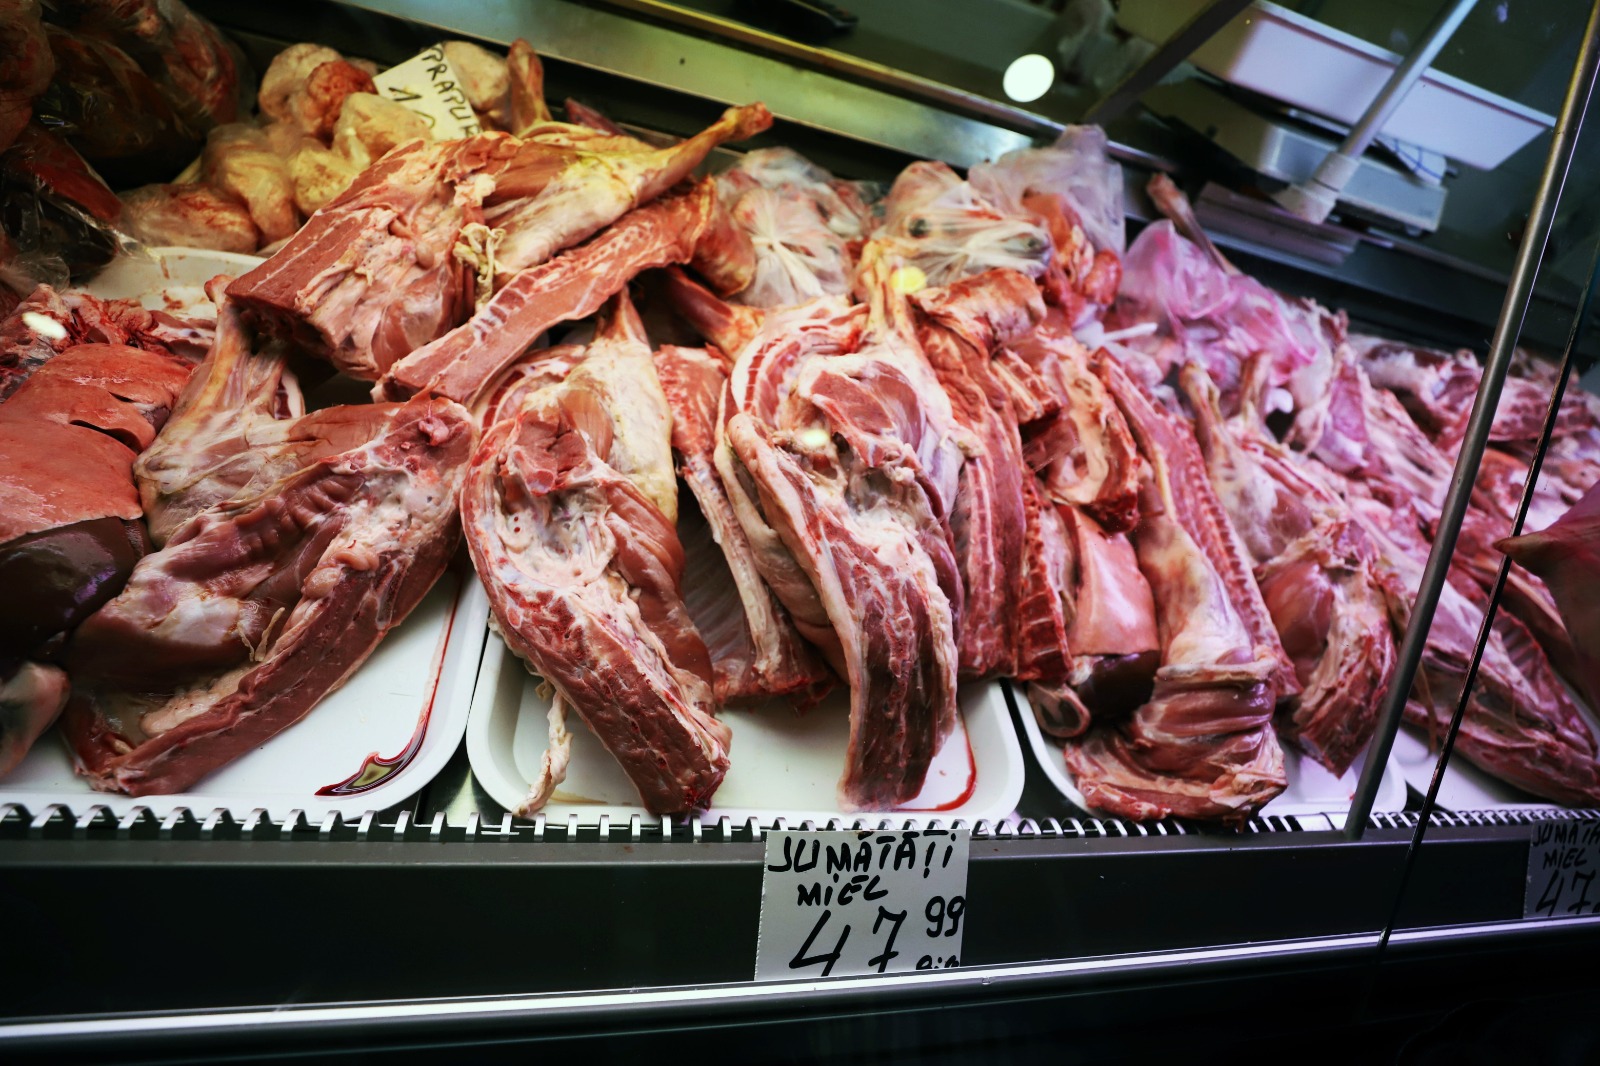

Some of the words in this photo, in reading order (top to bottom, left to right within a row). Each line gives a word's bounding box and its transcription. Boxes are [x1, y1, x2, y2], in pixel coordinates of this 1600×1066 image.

[1535, 869, 1597, 917] 47
[788, 905, 907, 977] 47
[925, 895, 966, 938] 99
